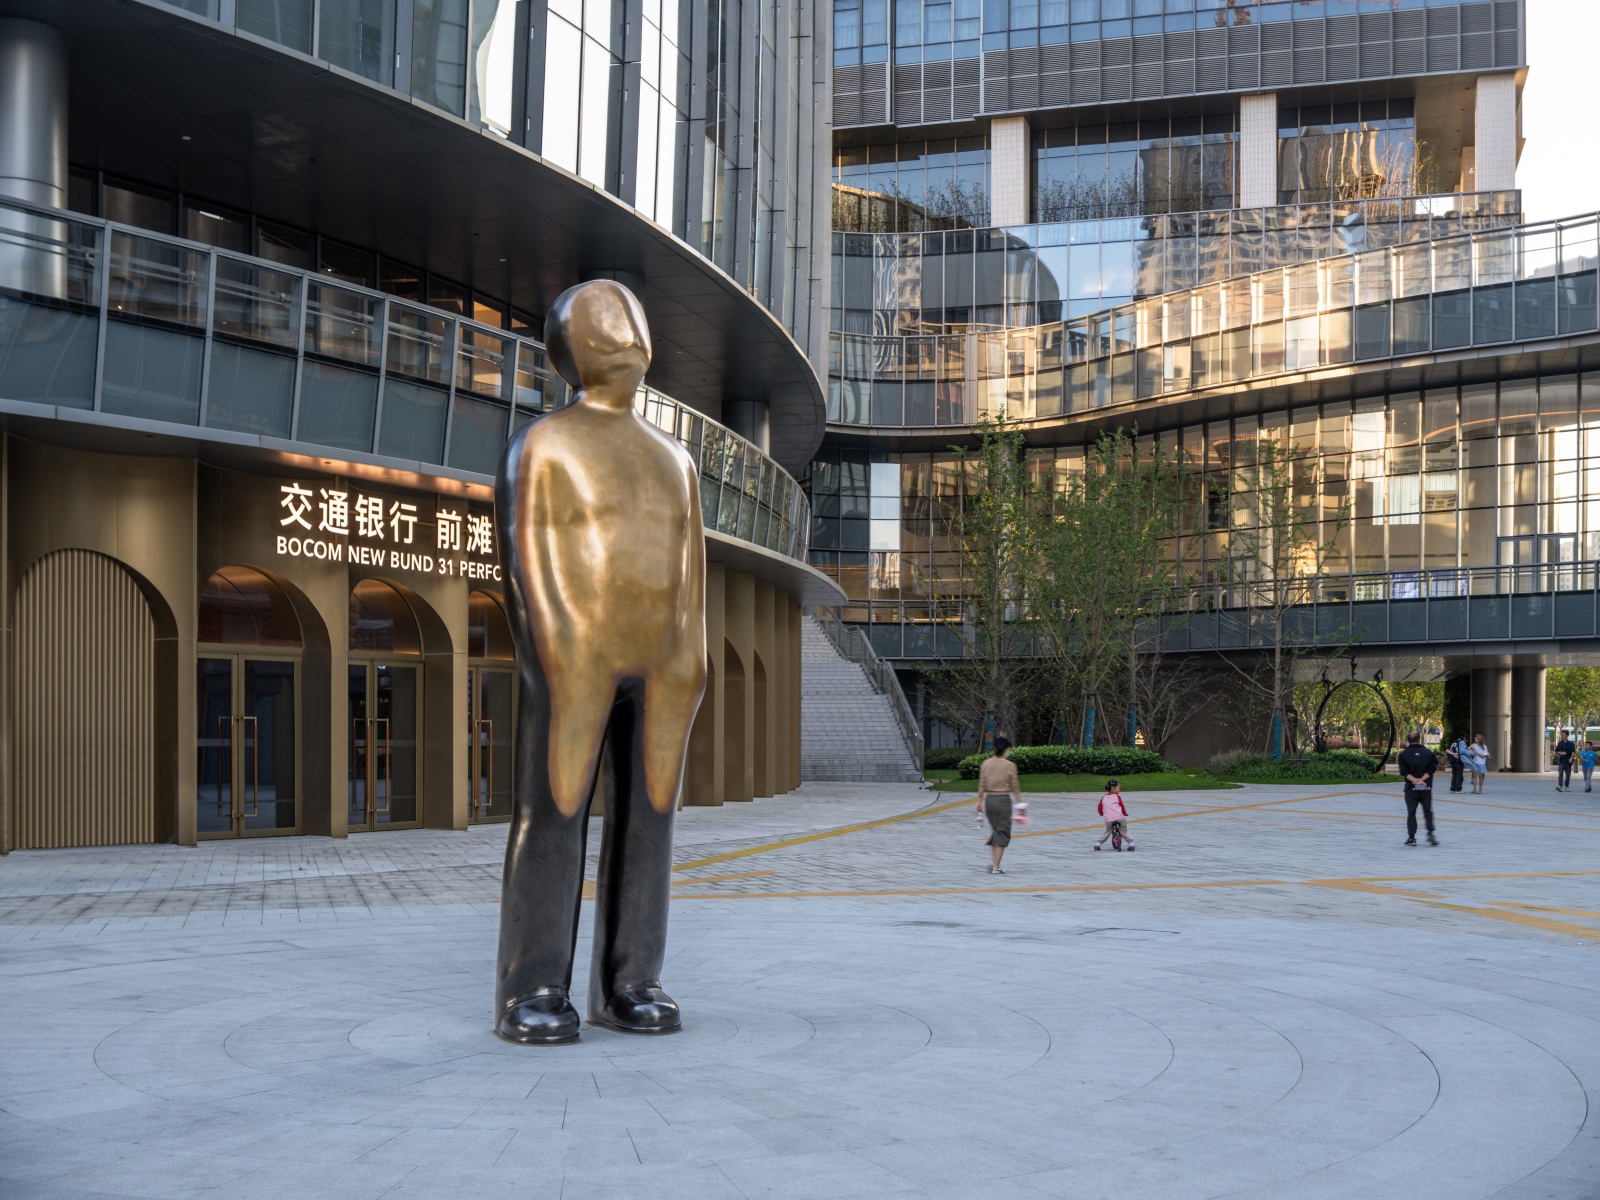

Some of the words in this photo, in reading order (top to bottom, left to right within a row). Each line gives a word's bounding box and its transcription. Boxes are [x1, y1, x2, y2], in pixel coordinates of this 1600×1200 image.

[280, 483, 418, 544] 交通银行
[436, 509, 492, 555] 前滩
[277, 536, 342, 561] BOCOM
[348, 545, 385, 567] NEW
[390, 551, 434, 573] BUND
[438, 557, 453, 575] 31
